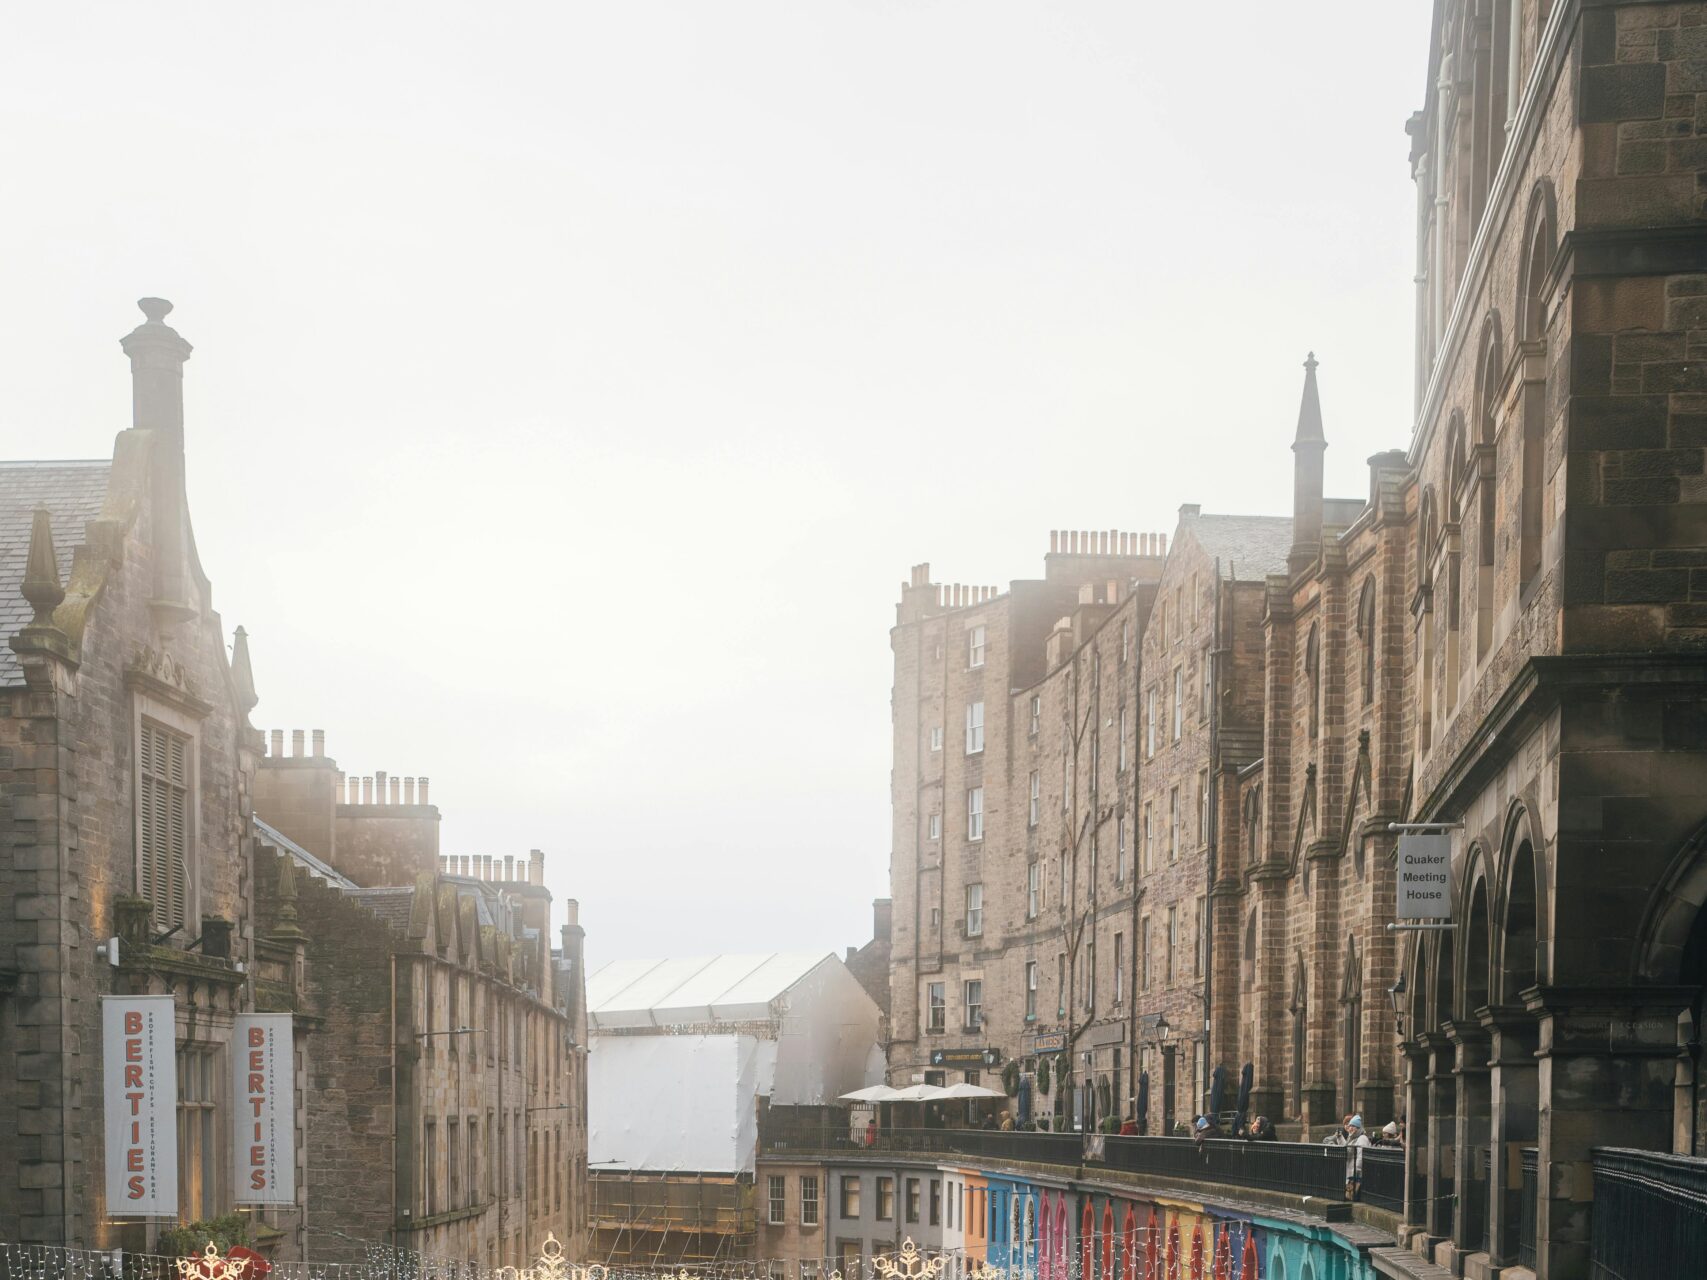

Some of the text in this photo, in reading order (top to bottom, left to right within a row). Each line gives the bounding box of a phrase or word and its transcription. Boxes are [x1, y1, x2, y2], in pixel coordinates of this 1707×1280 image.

[1404, 854, 1446, 865] Quaker
[1403, 872, 1447, 884] Meeting
[1406, 890, 1442, 900] House
[124, 1011, 146, 1200] BERTIES
[248, 1027, 266, 1191] BERTIES
